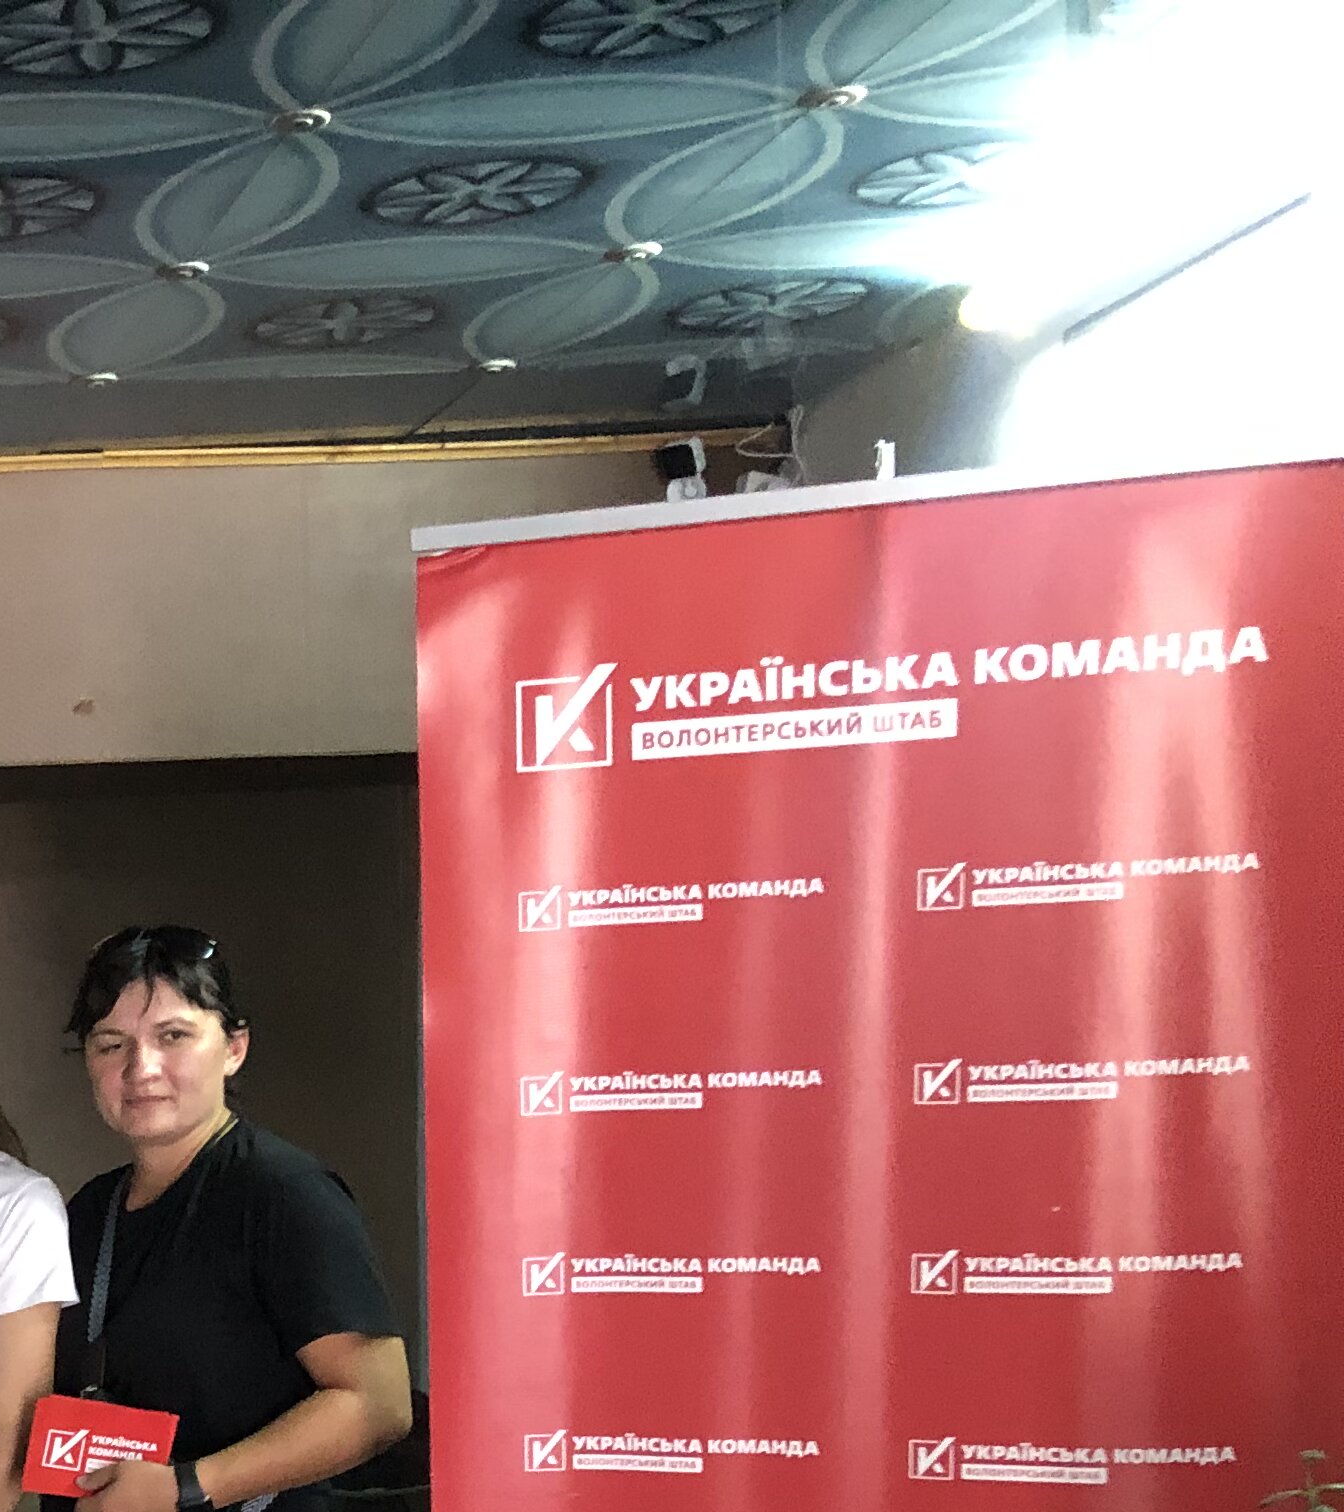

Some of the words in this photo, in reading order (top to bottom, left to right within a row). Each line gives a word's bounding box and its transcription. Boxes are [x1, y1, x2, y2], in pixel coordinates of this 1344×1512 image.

[630, 651, 961, 712] УКРАЇНСЬКА
[973, 626, 1269, 685] КОМАНДА
[641, 711, 863, 751] ВОЛОНТЕРСЬКИЙ
[871, 709, 943, 734] ШТАБ
[973, 861, 1123, 885] УКРАЇНСЬКА
[1130, 853, 1260, 877] КОМАНДА
[568, 884, 702, 907] УКРАЇНСЬКА
[708, 877, 824, 899] КОМАНДА
[573, 910, 664, 923] ВОЛОНТЕРСЬКИЙ
[968, 1060, 1117, 1081] УКРАЇНСЬКА
[1124, 1056, 1251, 1076] КОМАНДА
[570, 1071, 702, 1091] УКРАЇНСЬКА
[708, 1070, 822, 1088] КОМАНДА
[575, 1096, 665, 1108] ВОЛОНТЕРСЬКИЙ
[571, 1254, 702, 1274] УКРАЇНСЬКА
[708, 1258, 821, 1275] КОМАНДА
[964, 1254, 1112, 1272] УКРАЇНСЬКА
[1119, 1253, 1243, 1272] КОМАНДА
[575, 1278, 665, 1289] ВОЛОНТЕРСЬКИЙ
[88, 1446, 143, 1460] КОМАНДА
[91, 1434, 158, 1452] УКРАЇНСЬКА
[572, 1433, 702, 1453] УКРАЇНСЬКА
[708, 1439, 820, 1457] КОМАНДА
[961, 1442, 1107, 1463] УКРАЇНСЬКА
[1114, 1446, 1236, 1465] КОМАНДА
